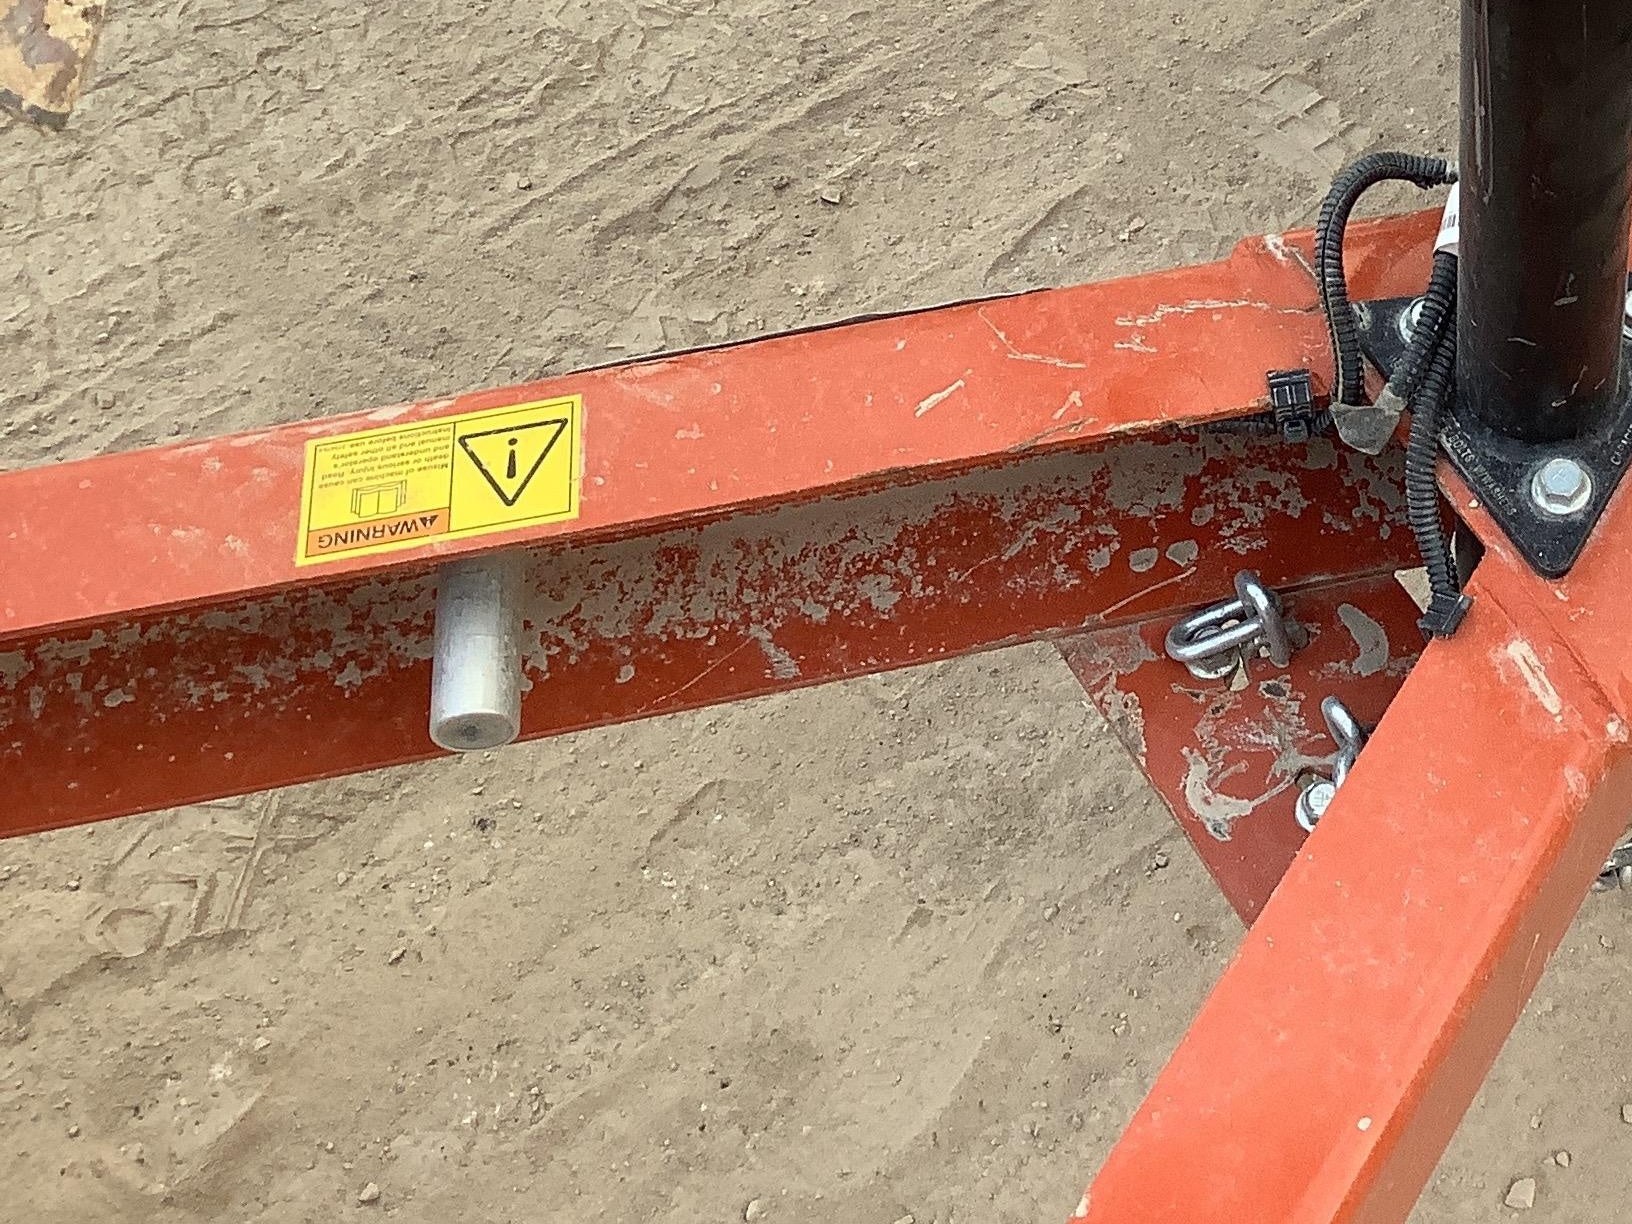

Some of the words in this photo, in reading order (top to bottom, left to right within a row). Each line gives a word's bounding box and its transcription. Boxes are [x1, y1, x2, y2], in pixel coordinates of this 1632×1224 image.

[380, 447, 431, 461] understand
[365, 470, 403, 482] machine
[317, 518, 416, 549] WARNING
